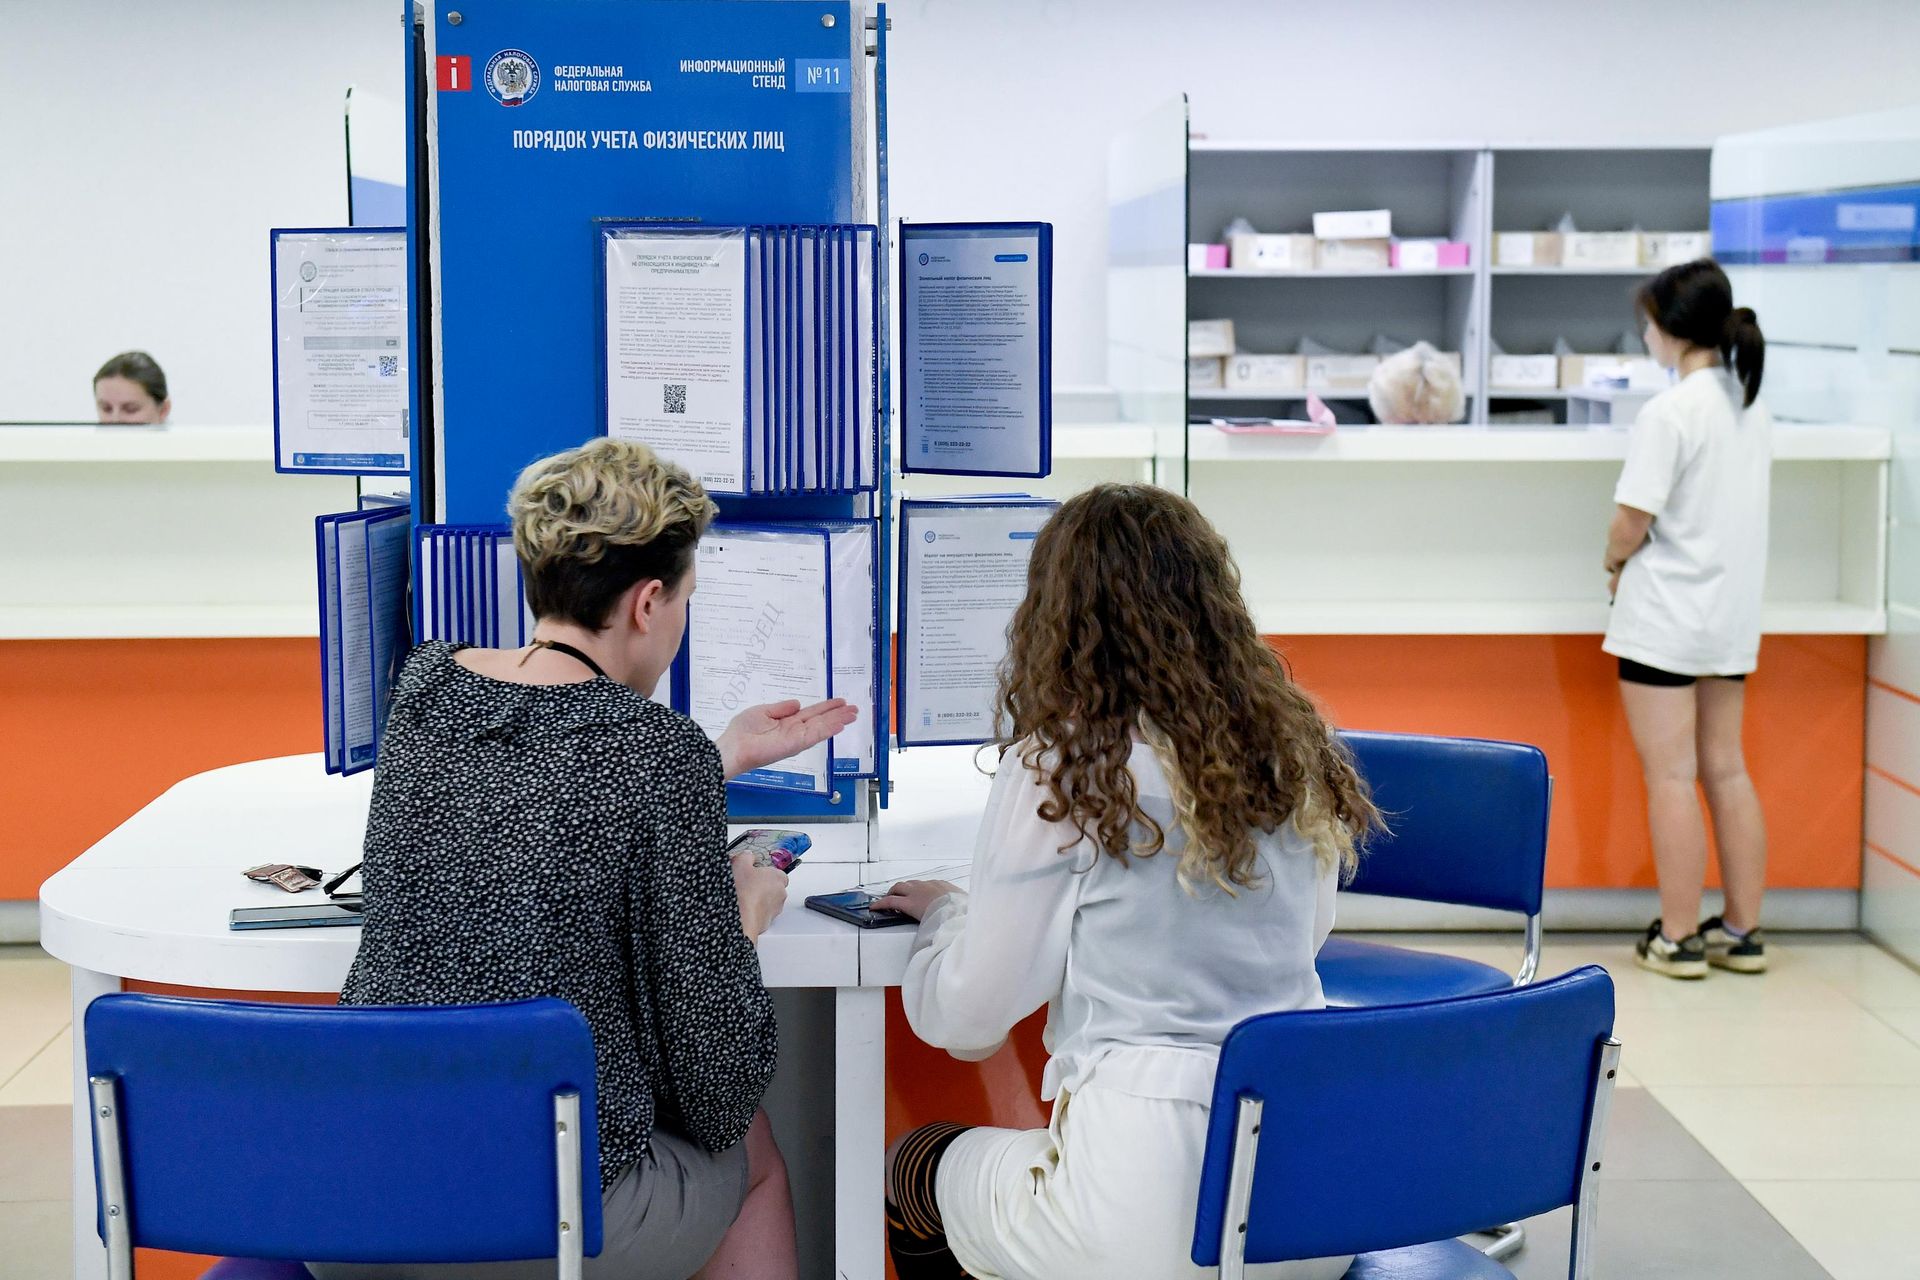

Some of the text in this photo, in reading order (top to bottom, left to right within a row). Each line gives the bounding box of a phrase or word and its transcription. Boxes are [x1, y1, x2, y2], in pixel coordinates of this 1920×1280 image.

[554, 65, 623, 78] ФЕДЕРАЛЬНАЯ
[680, 58, 786, 75] ИНФОРМАЦИОННЫЙ
[752, 74, 786, 91] СТЕНД
[806, 66, 841, 85] №11
[554, 79, 652, 93] НАЛОГОВАЯ СЛУЖБА
[513, 130, 785, 152] ПОРЯДОК УЧЕТА ФИЗИЧЕСКИХ ЛИЦ
